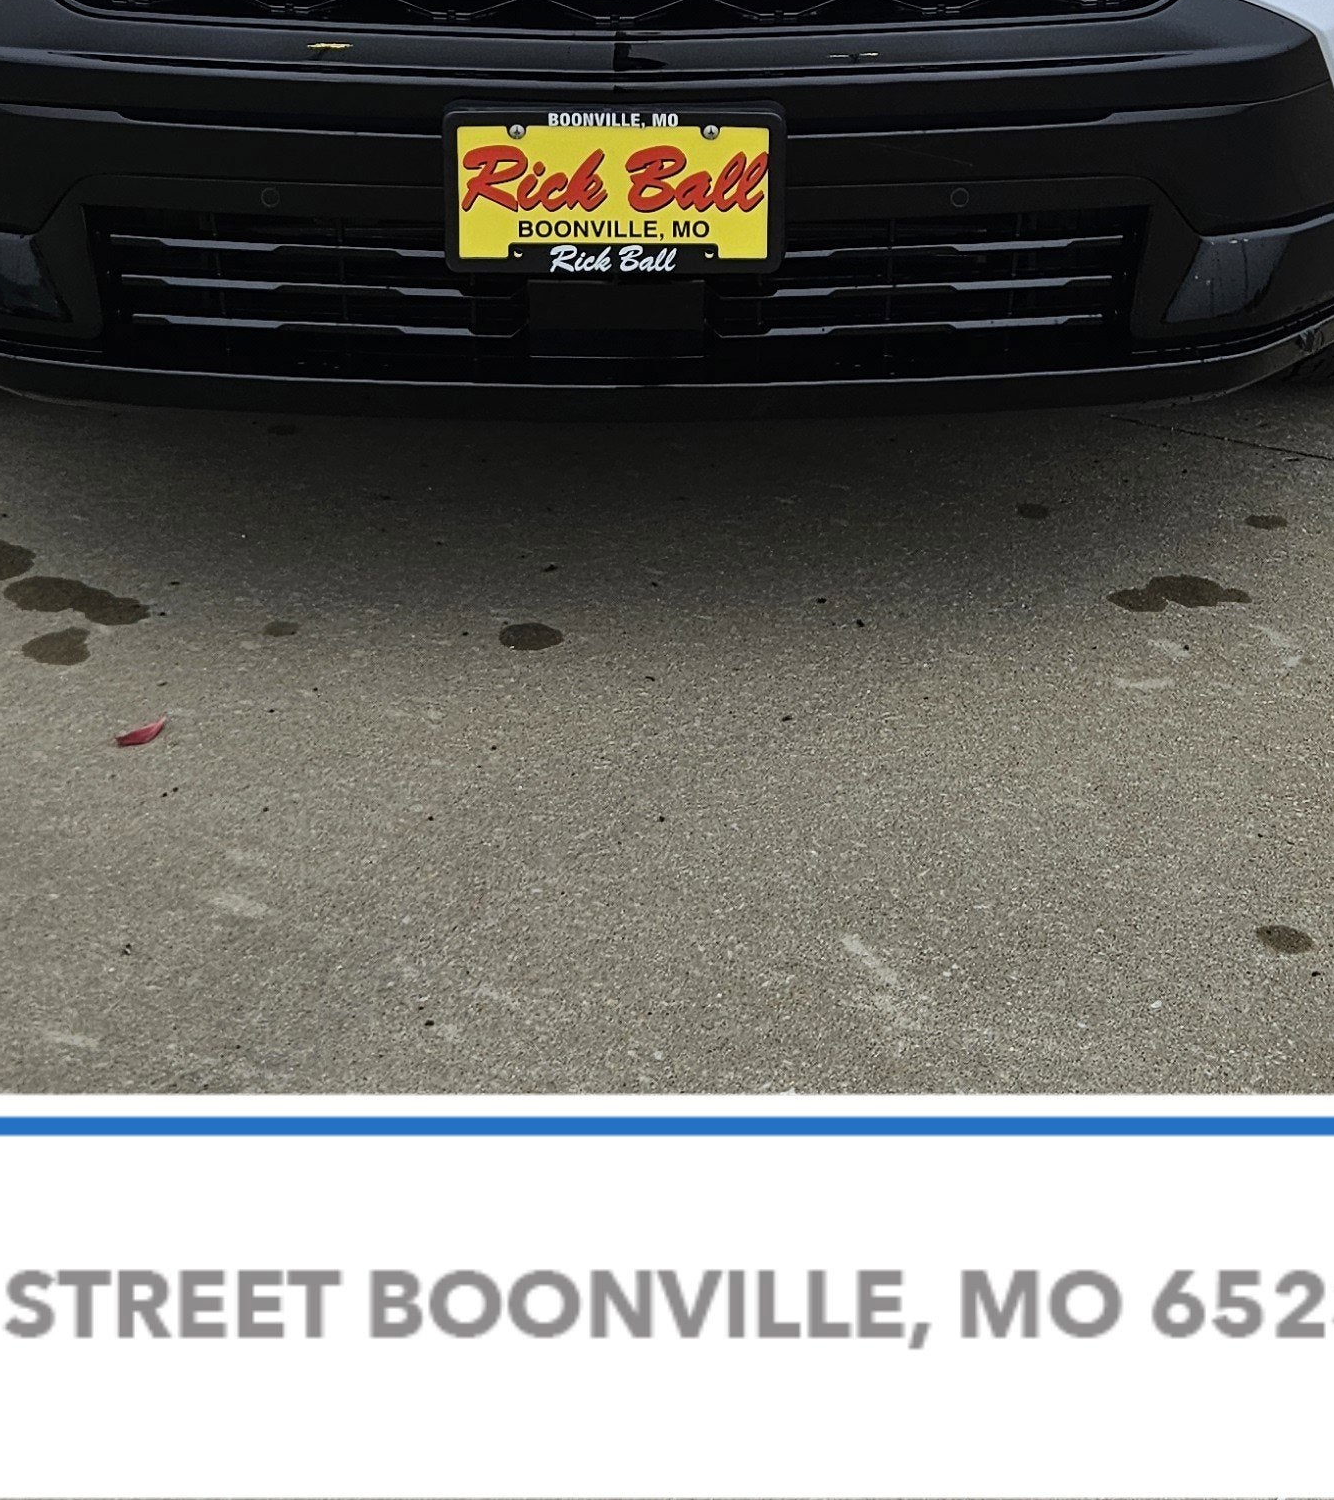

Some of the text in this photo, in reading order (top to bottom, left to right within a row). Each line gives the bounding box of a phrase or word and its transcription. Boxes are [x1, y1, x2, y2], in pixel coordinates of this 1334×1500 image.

[547, 112, 679, 129] BOONVILLE, MO
[461, 144, 769, 213] Rick Ball
[518, 219, 710, 241] BOONVILLE, MO
[549, 244, 678, 274] Rick Ball
